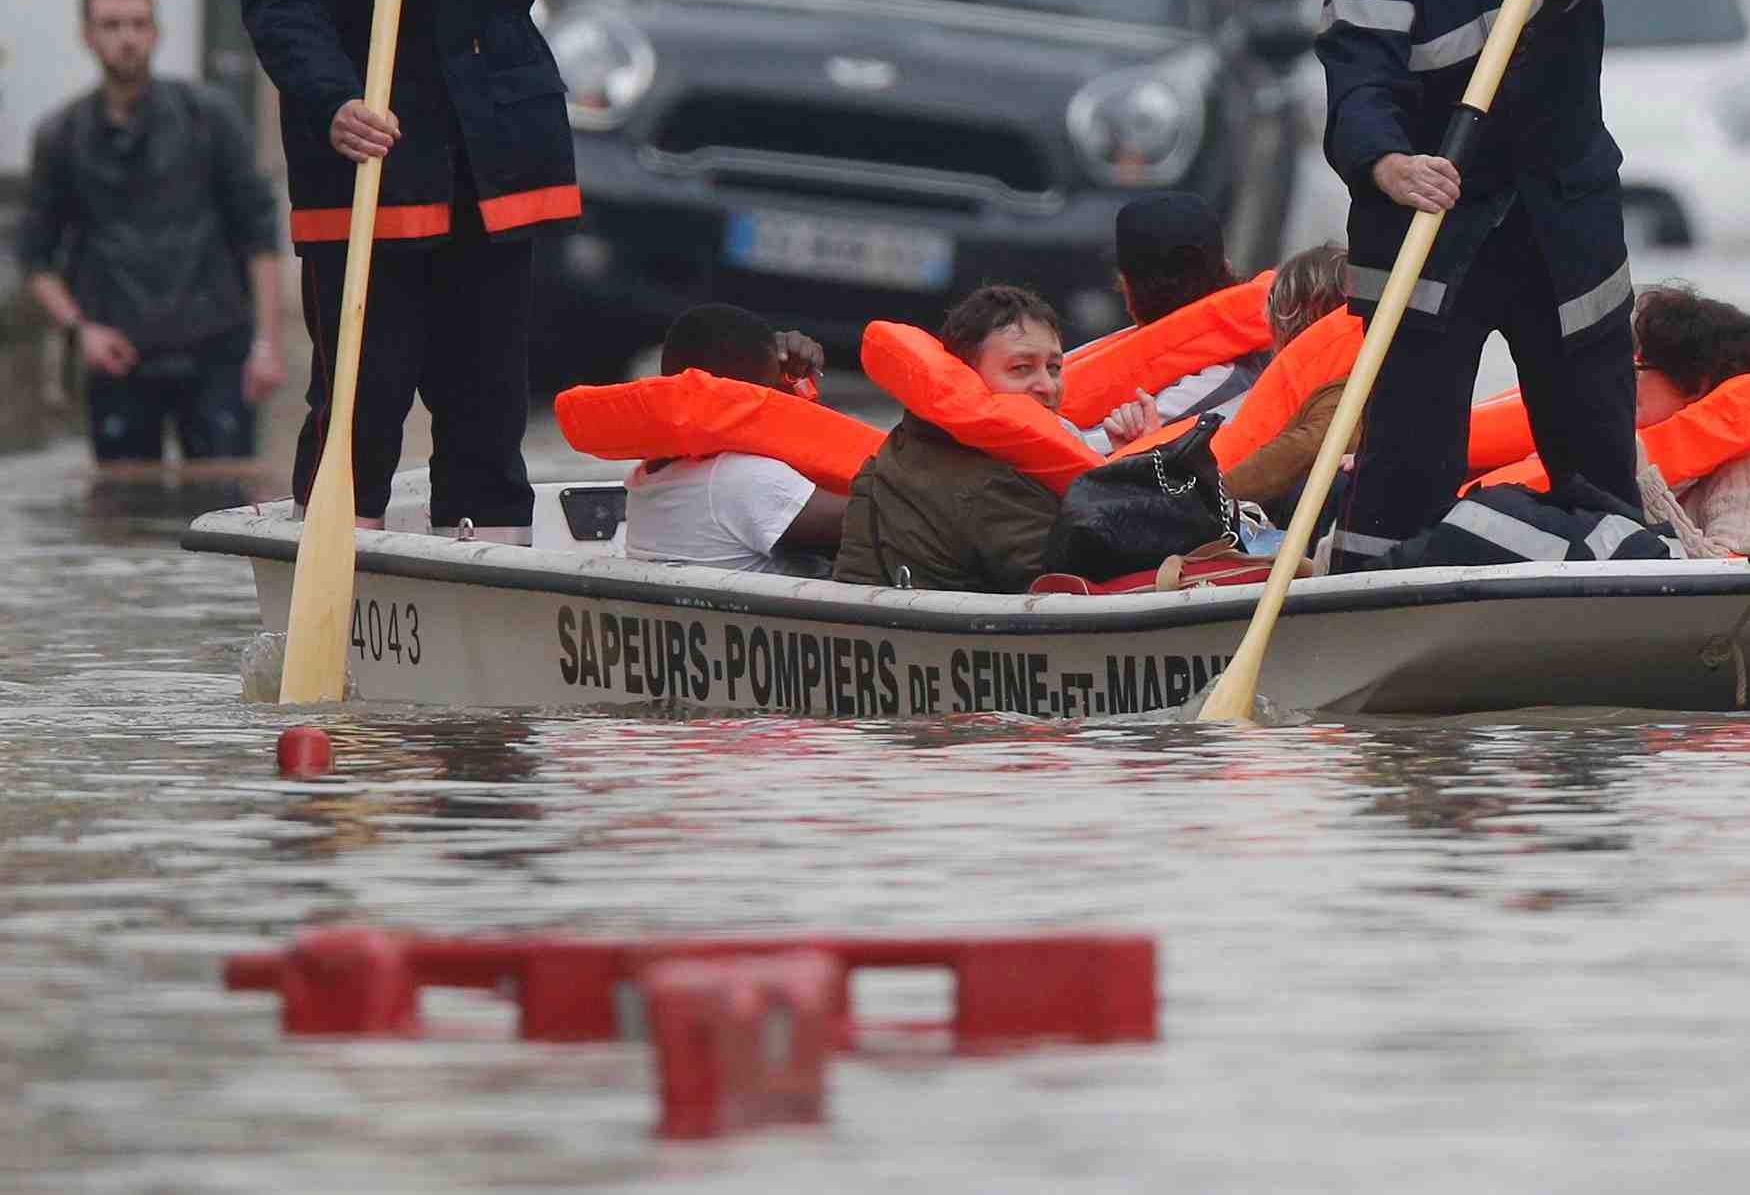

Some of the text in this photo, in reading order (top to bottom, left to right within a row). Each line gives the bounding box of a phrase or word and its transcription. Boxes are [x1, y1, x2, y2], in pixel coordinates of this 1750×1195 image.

[351, 598, 421, 665] 4043
[557, 604, 899, 717] SAPEURS-POMPIERS
[951, 648, 1235, 719] SEINE-ET-MARN
